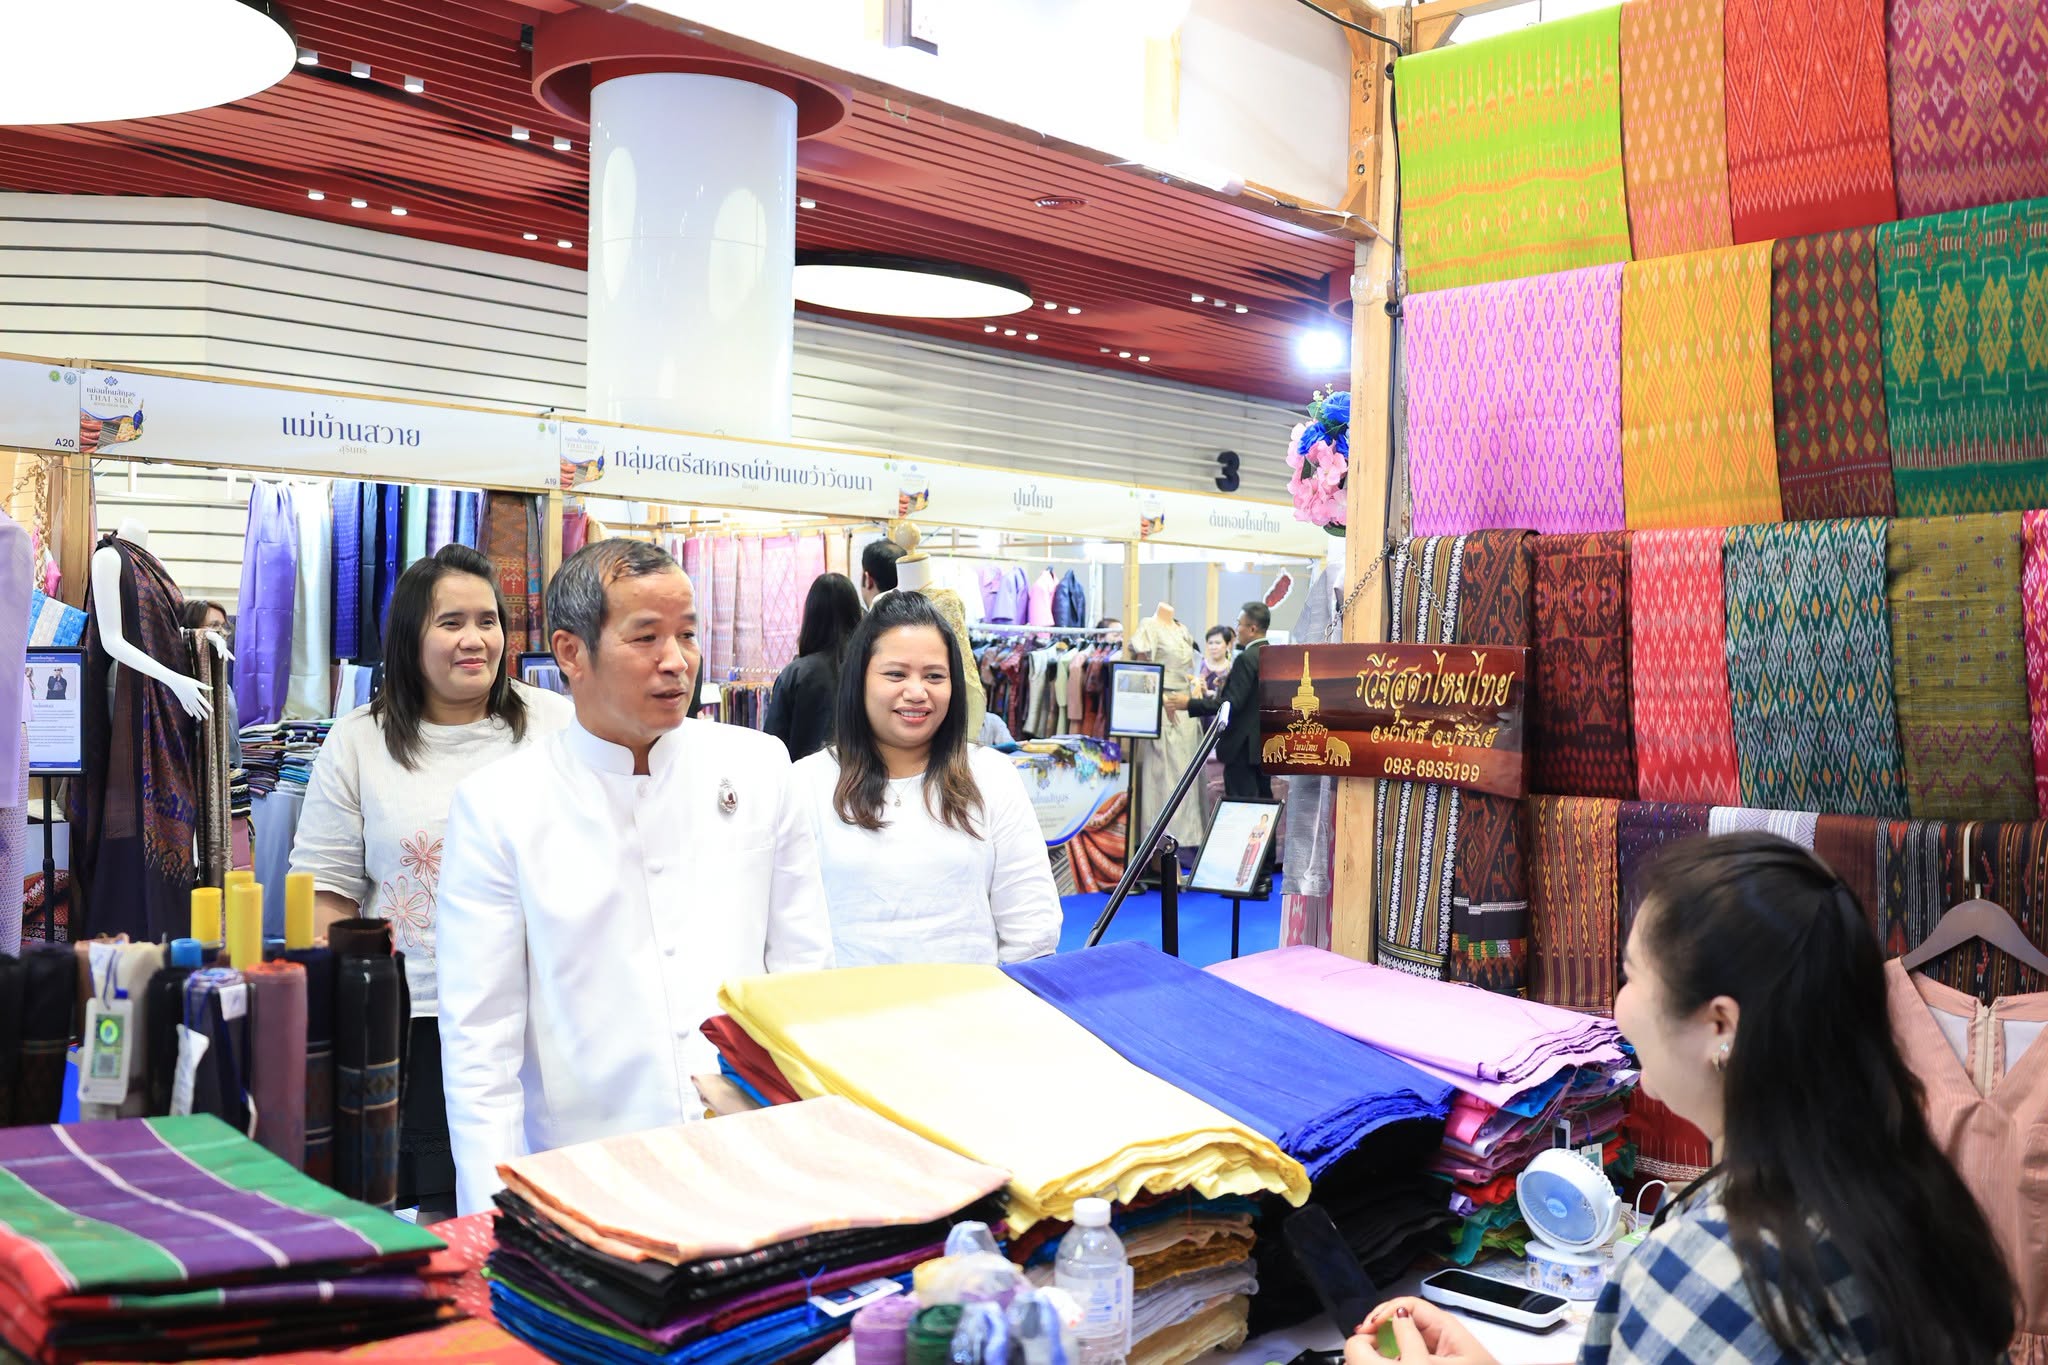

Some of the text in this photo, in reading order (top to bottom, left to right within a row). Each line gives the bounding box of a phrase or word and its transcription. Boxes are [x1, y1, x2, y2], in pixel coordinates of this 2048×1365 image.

[88, 394, 111, 403] THAI
[114, 396, 134, 405] SILK
[282, 411, 421, 447] แม่บ้านสวาย
[55, 438, 75, 448] A20
[544, 477, 557, 486] A19
[615, 445, 873, 491] กลุ่มสตรีสหกรณ์บ้านเขว้าวัฒนา
[1215, 451, 1240, 492] 3
[1383, 756, 1480, 783] 098-6935199
